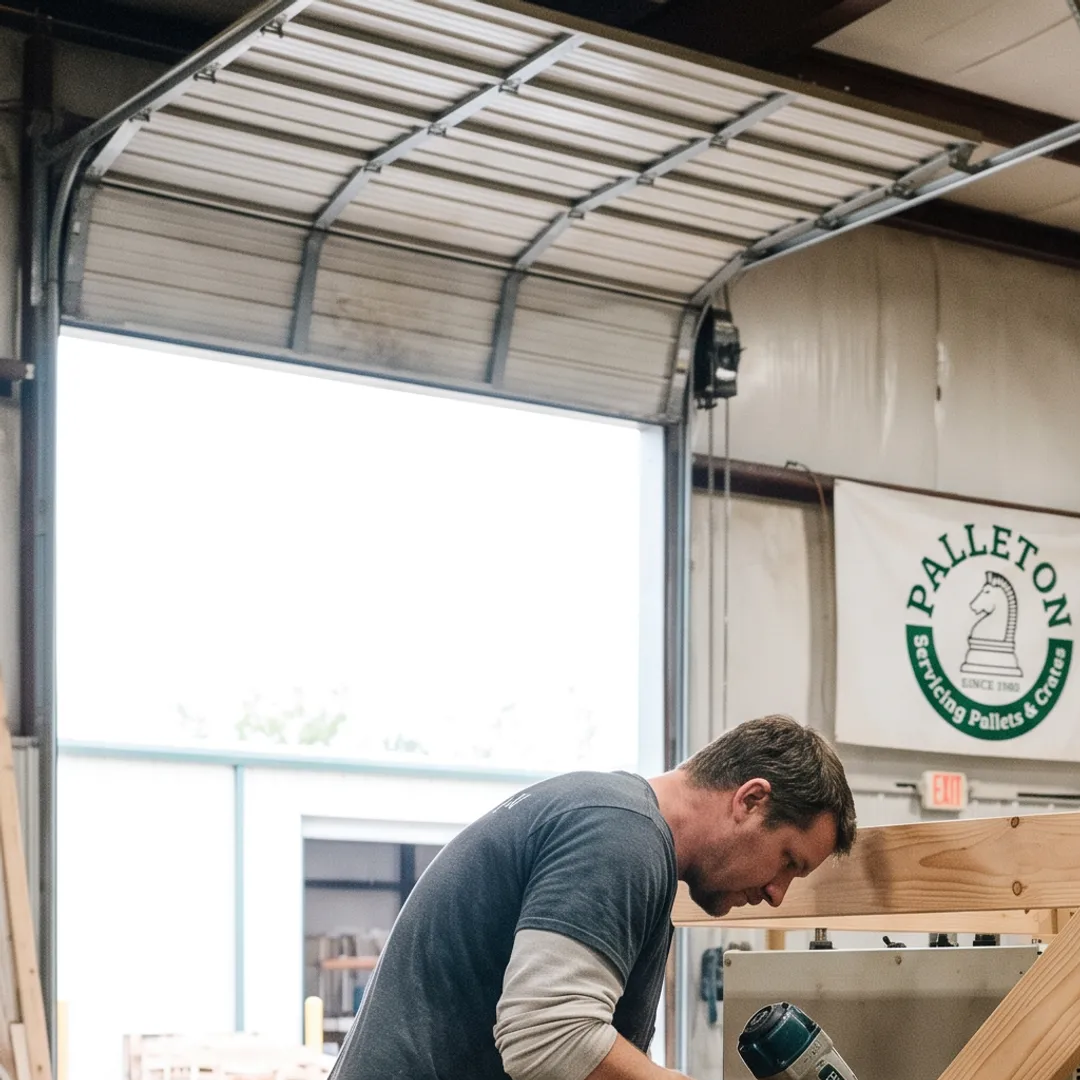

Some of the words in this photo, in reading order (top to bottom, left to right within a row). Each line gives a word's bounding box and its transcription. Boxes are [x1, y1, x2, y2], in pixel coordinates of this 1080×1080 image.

[907, 524, 1072, 628] PALLETON
[913, 634, 967, 724] Servicing
[968, 708, 1025, 731] Pallets
[1023, 701, 1039, 719] &
[1034, 647, 1067, 706] Crates
[933, 775, 961, 805] EXIT
